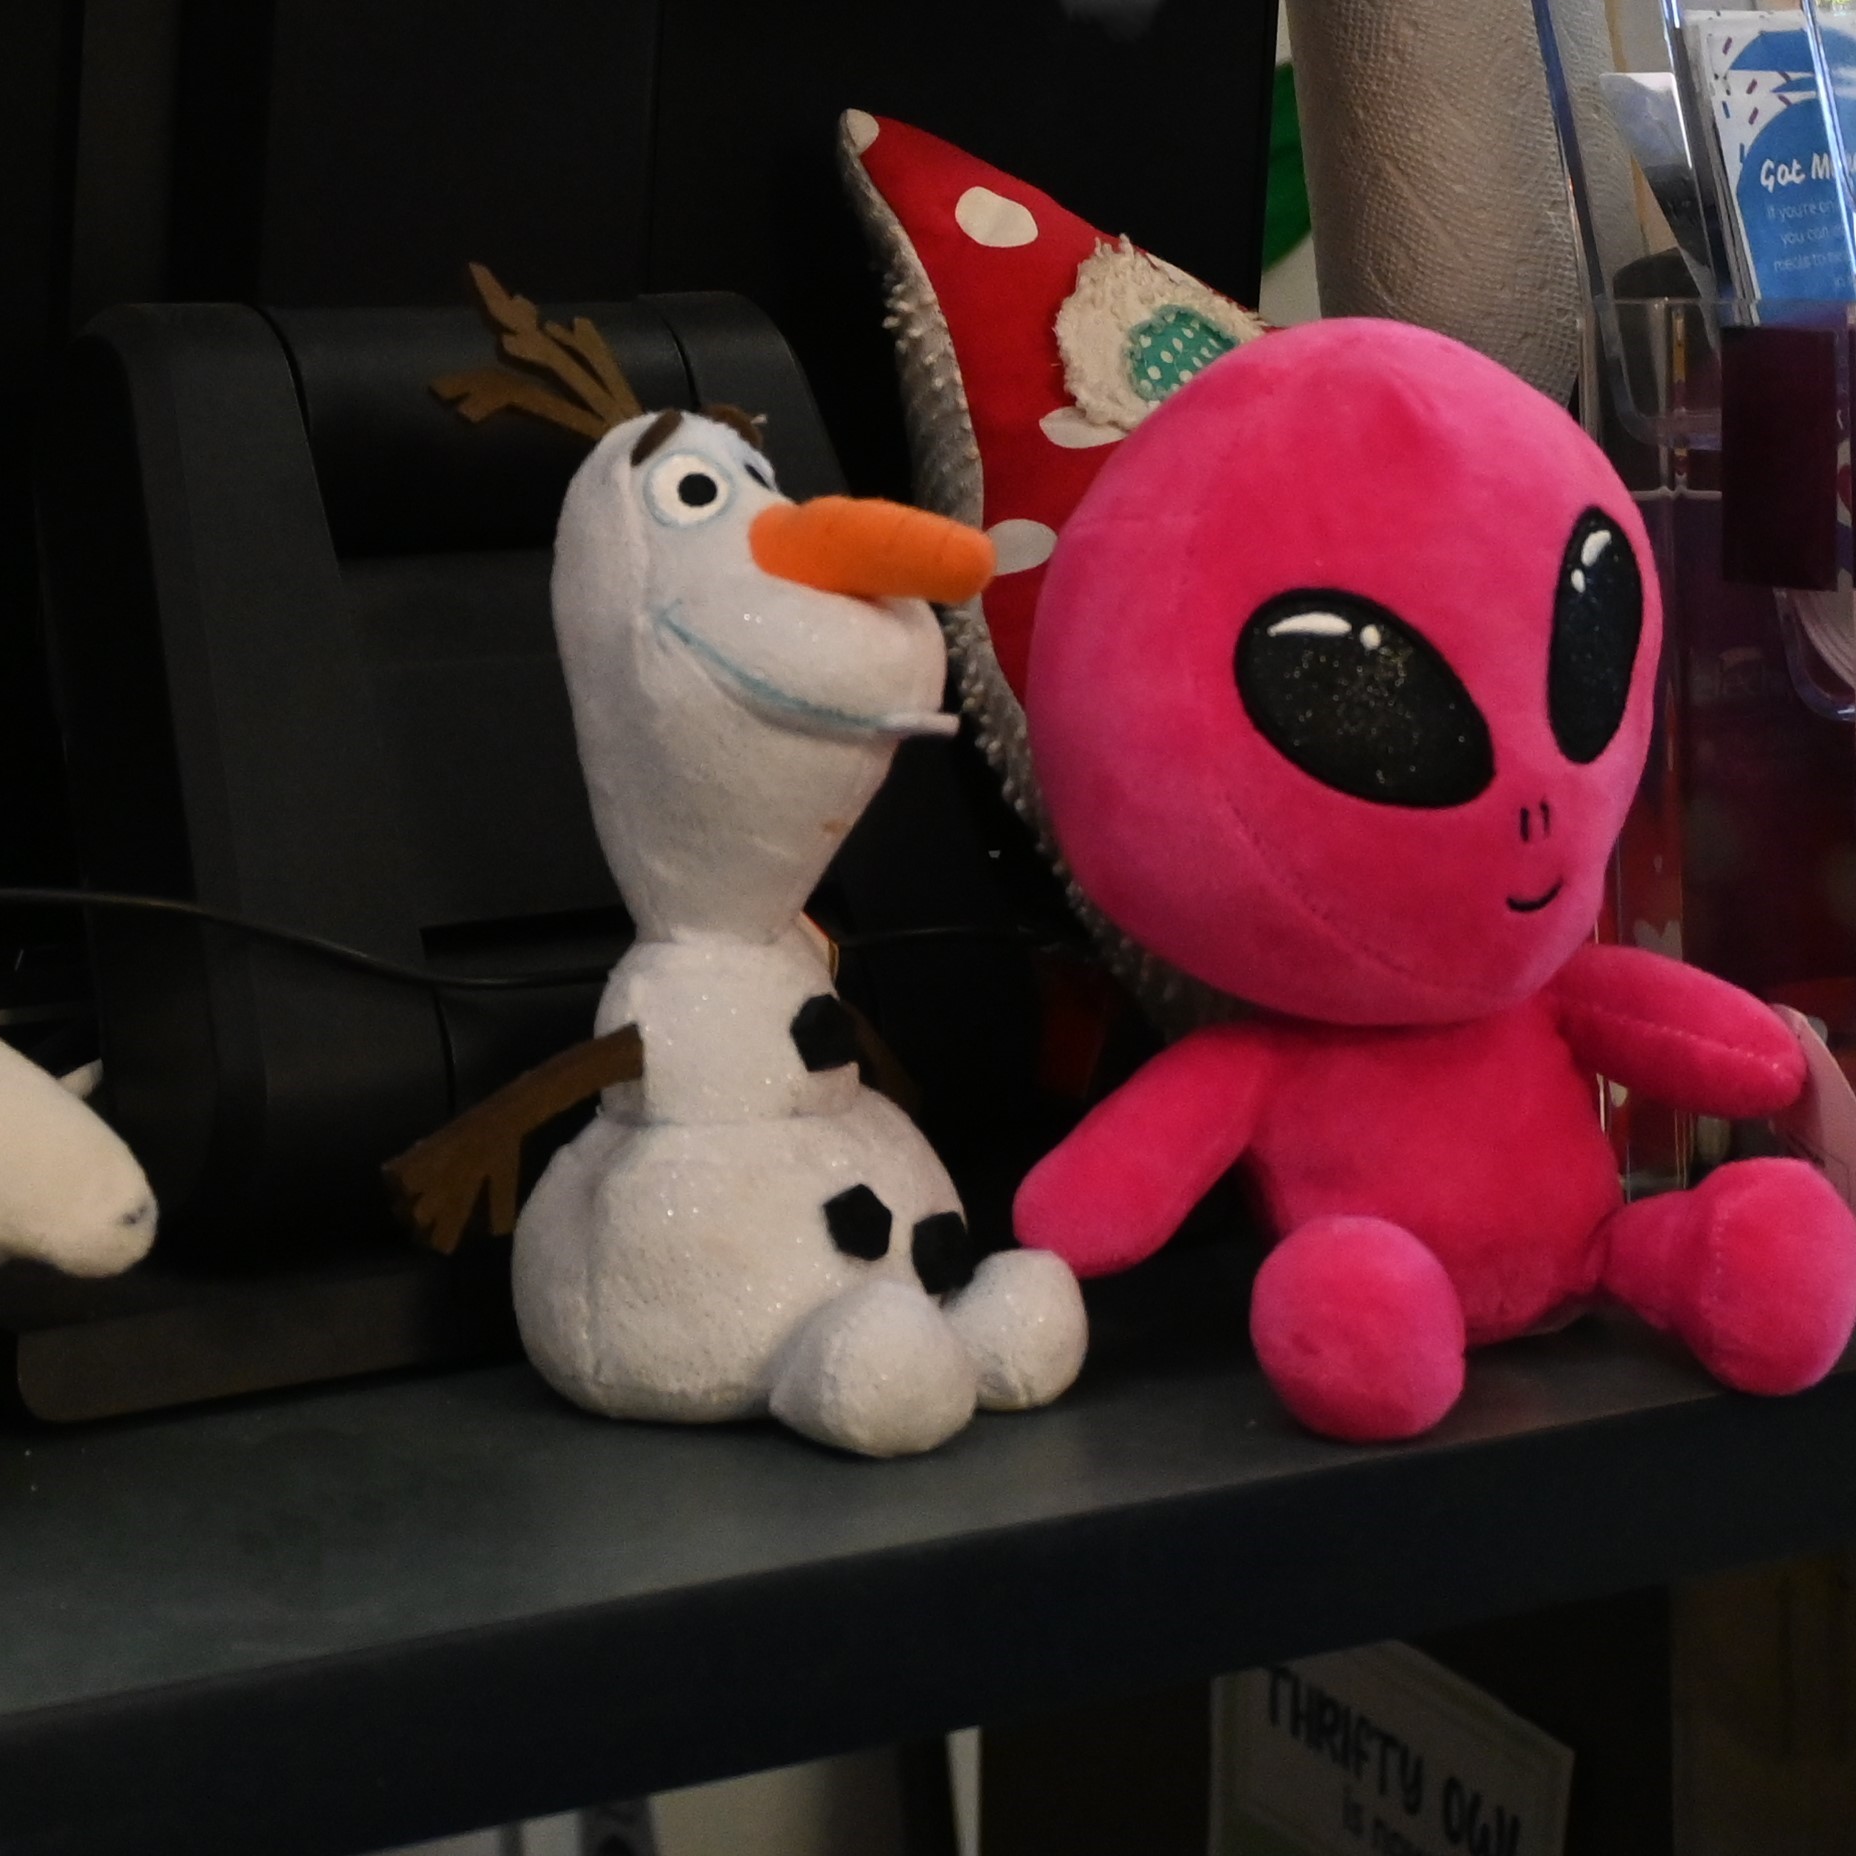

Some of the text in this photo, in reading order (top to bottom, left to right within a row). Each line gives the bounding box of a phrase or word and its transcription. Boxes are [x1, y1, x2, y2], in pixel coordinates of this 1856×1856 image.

[1760, 158, 1805, 194] Got
[1781, 231, 1805, 245] you
[1269, 1665, 1424, 1815] THRIFTY
